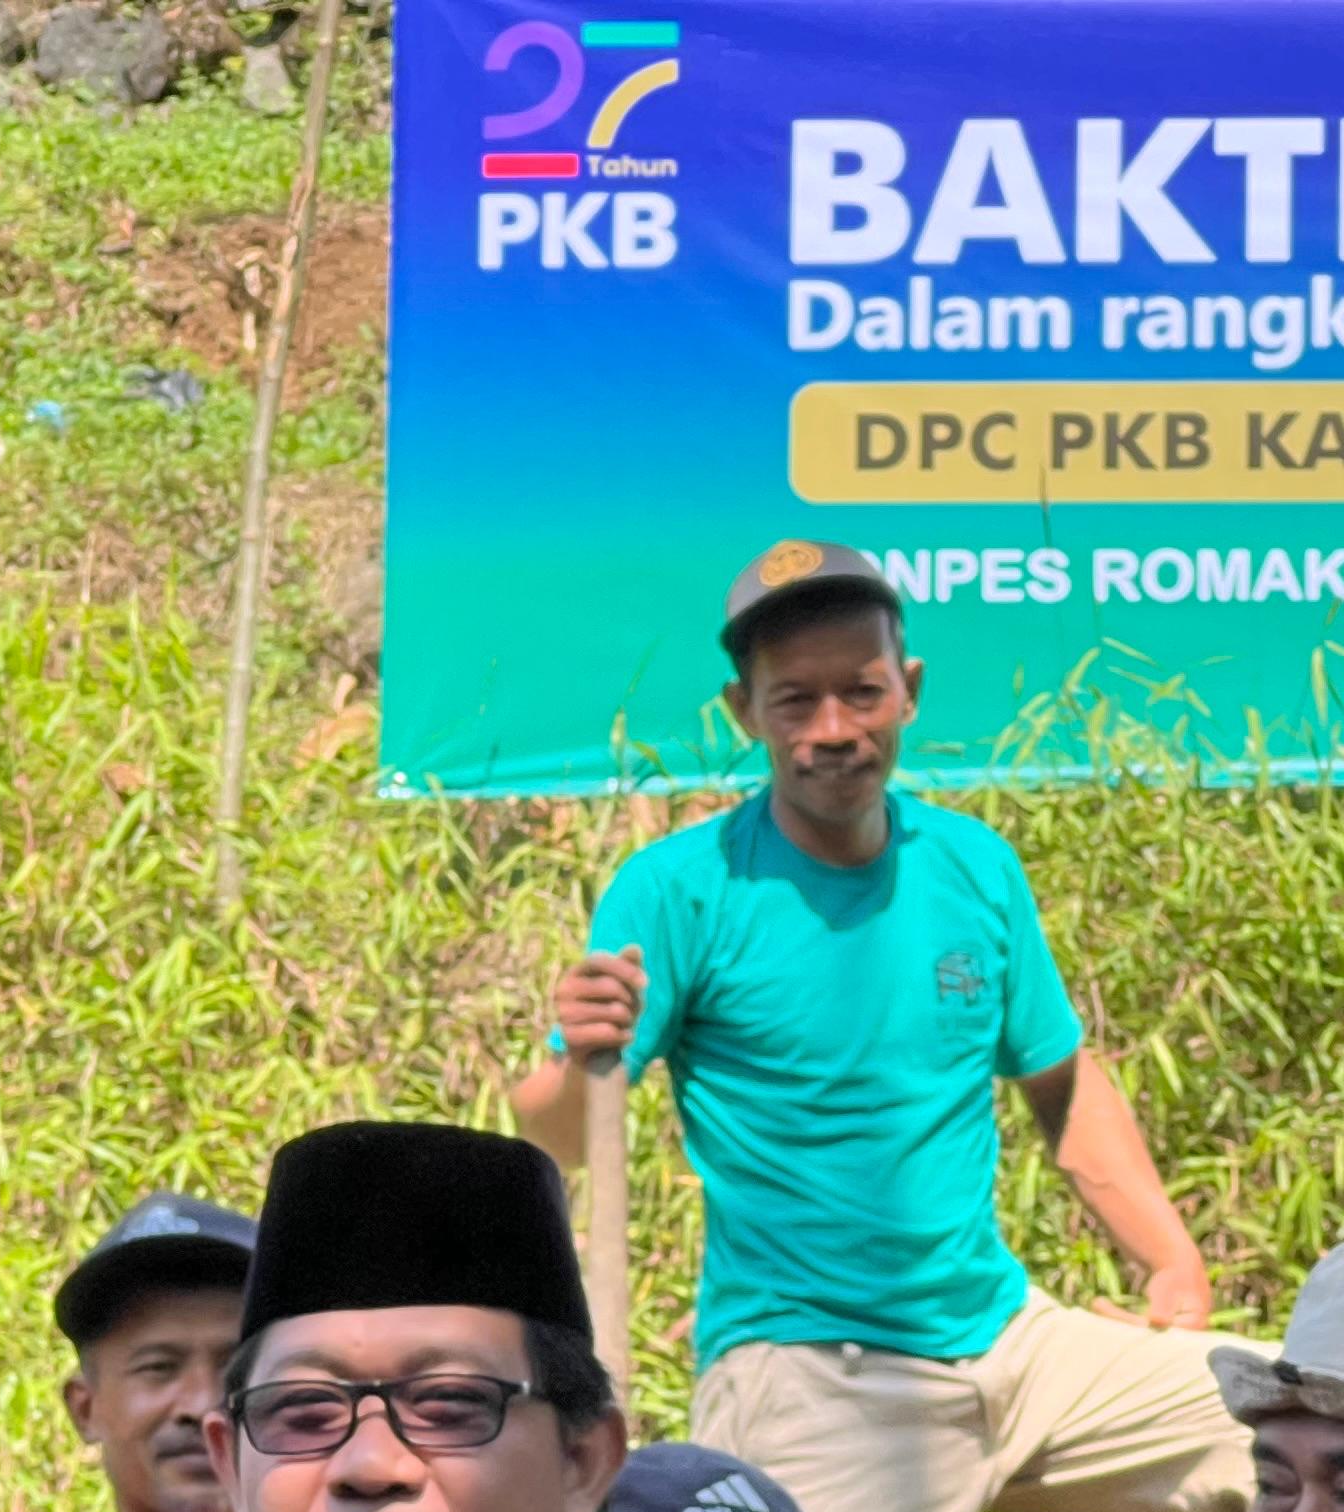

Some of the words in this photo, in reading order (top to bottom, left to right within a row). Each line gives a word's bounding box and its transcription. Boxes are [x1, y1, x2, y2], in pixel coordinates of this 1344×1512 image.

[586, 155, 678, 178] Tahun
[478, 191, 678, 269] PKB
[788, 275, 1072, 351] Dalam
[855, 411, 1016, 471] DPC
[1050, 411, 1210, 471] PKB
